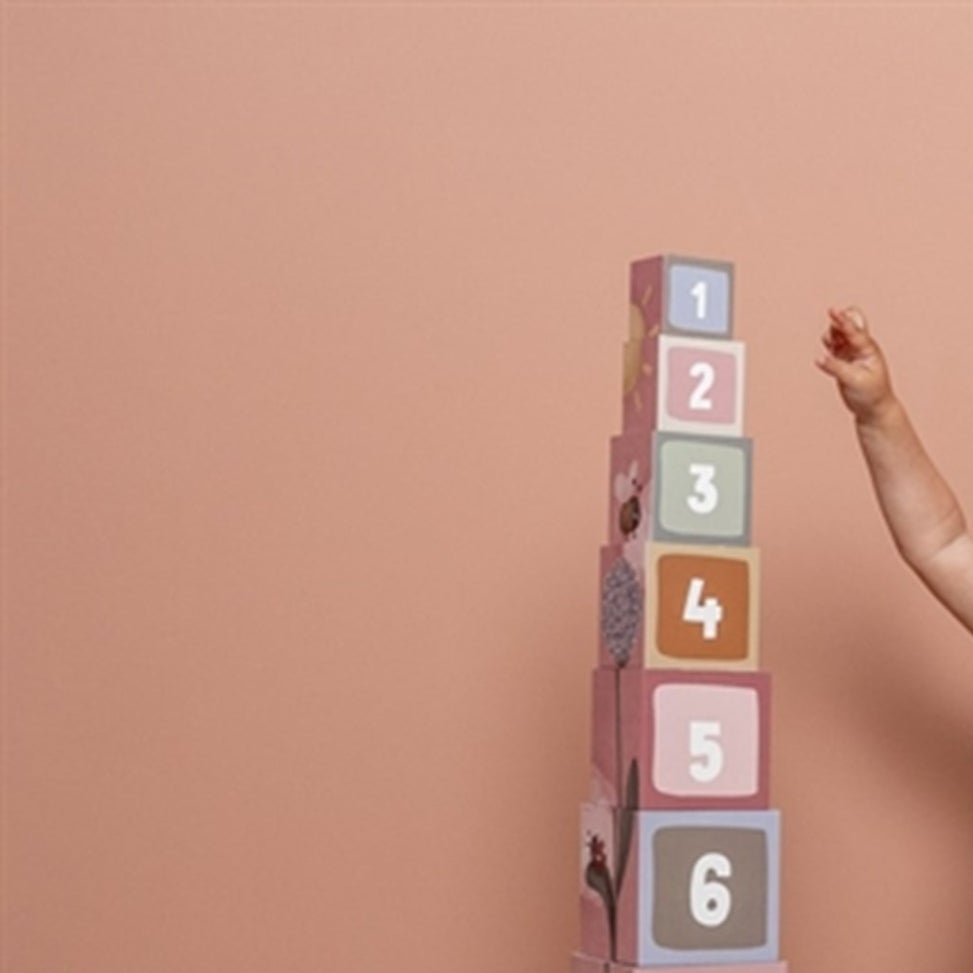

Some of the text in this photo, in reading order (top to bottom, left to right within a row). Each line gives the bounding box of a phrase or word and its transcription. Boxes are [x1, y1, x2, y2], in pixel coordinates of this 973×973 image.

[692, 282, 706, 318] 1
[689, 363, 714, 409] 2
[687, 464, 717, 513] 3
[683, 578, 722, 638] 4
[690, 721, 722, 782] 5
[691, 853, 731, 926] 6
